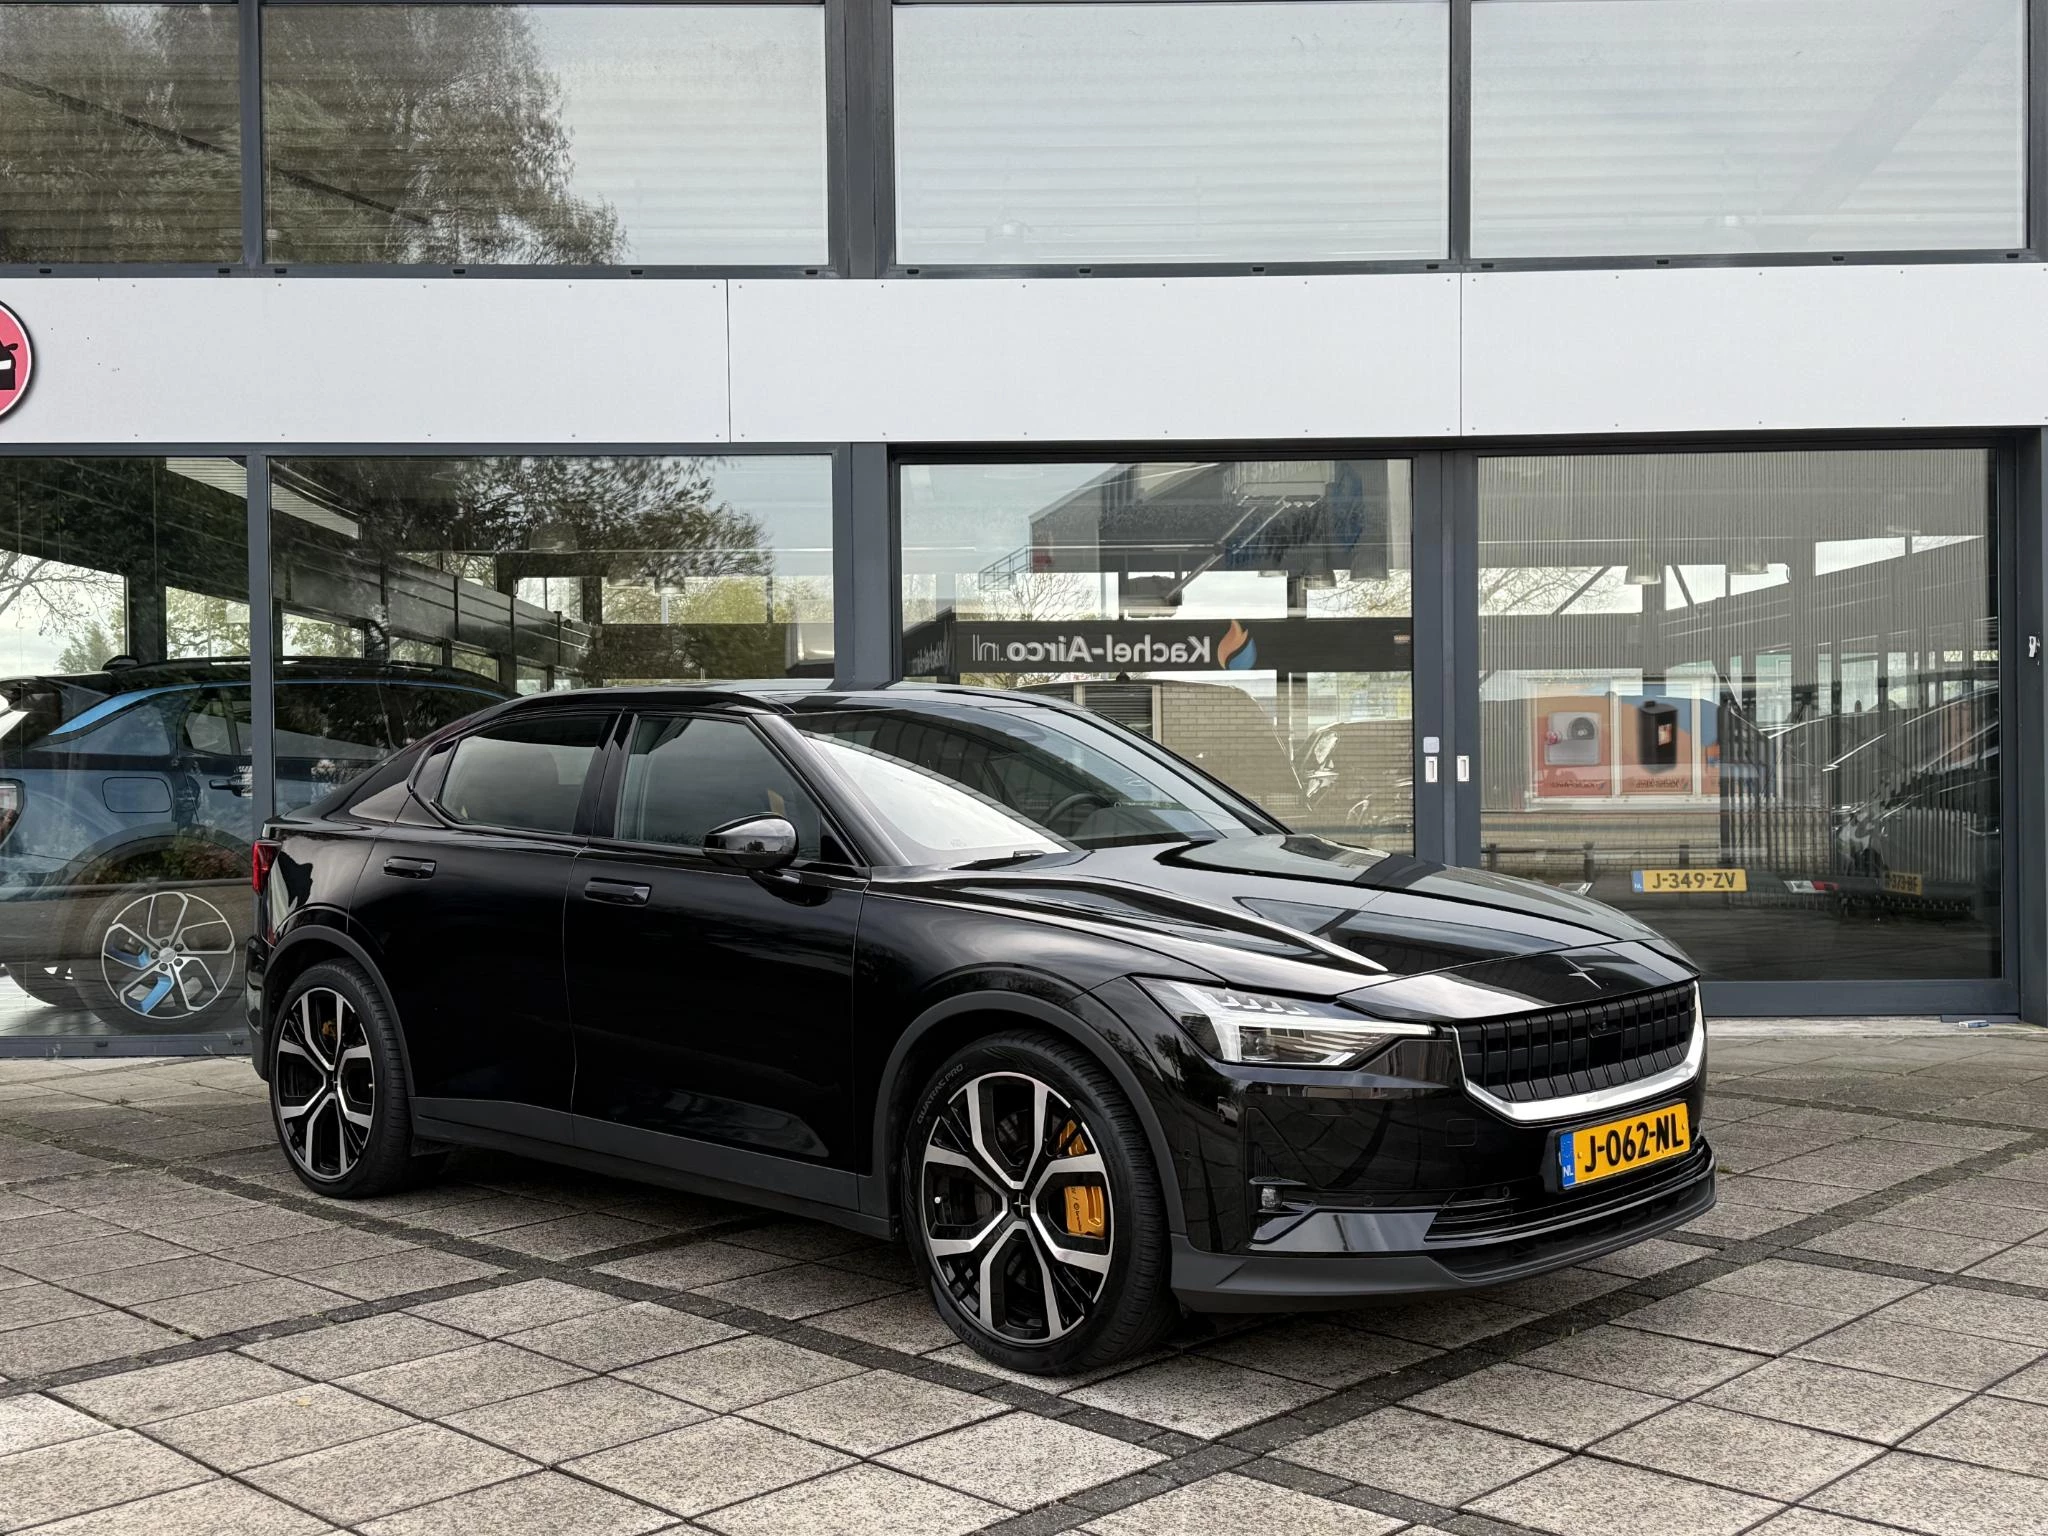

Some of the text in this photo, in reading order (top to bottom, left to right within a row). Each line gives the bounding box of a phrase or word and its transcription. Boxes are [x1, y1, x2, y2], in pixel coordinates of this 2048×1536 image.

[1652, 872, 1736, 889] J-349-ZV
[917, 1063, 964, 1124] QUATRAC PRO
[1585, 1113, 1684, 1173] J-062-NL
[1563, 1165, 1574, 1177] NL
